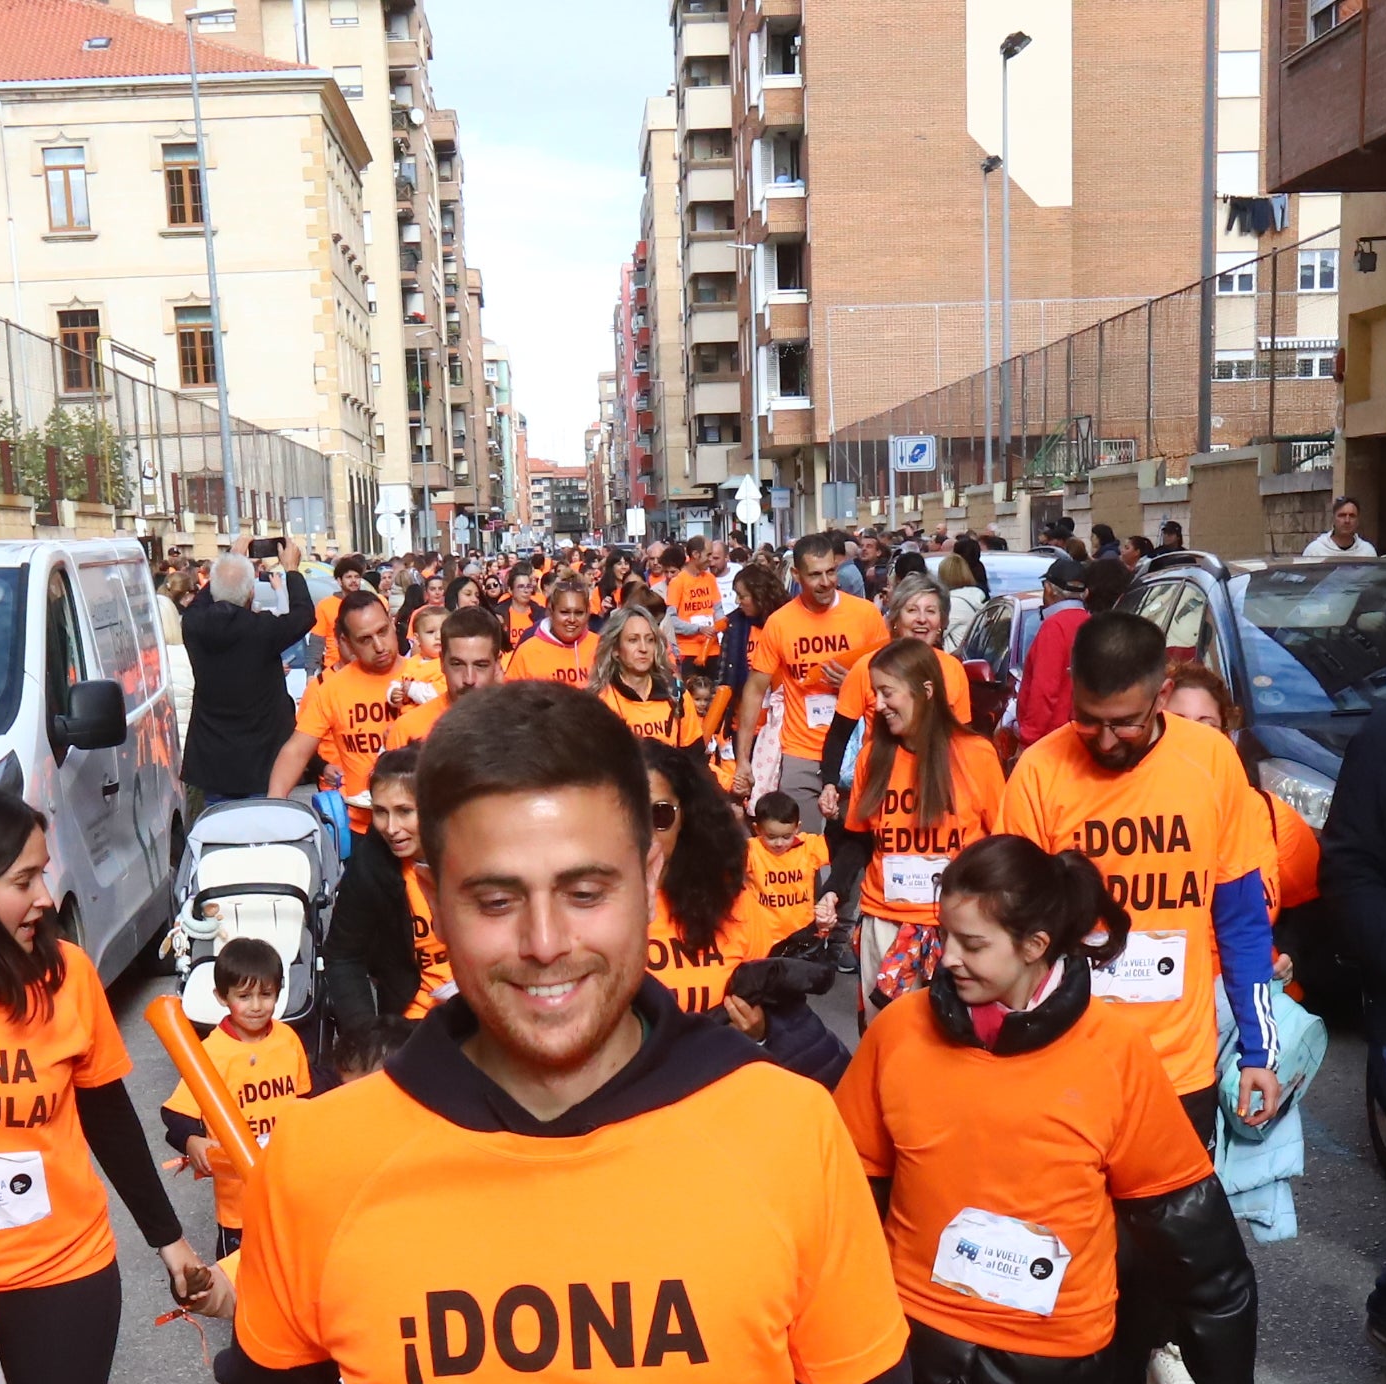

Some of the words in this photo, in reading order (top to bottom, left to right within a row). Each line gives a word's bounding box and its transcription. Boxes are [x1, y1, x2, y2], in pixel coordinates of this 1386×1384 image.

[349, 701, 401, 729] ¡DON
[1107, 869, 1208, 911] DULA!
[648, 937, 725, 971] ONA
[1133, 968, 1151, 977] COLE
[238, 1075, 295, 1109] ¡DONA
[996, 1247, 1029, 1265] VUELTA
[997, 1261, 1020, 1276] COLE
